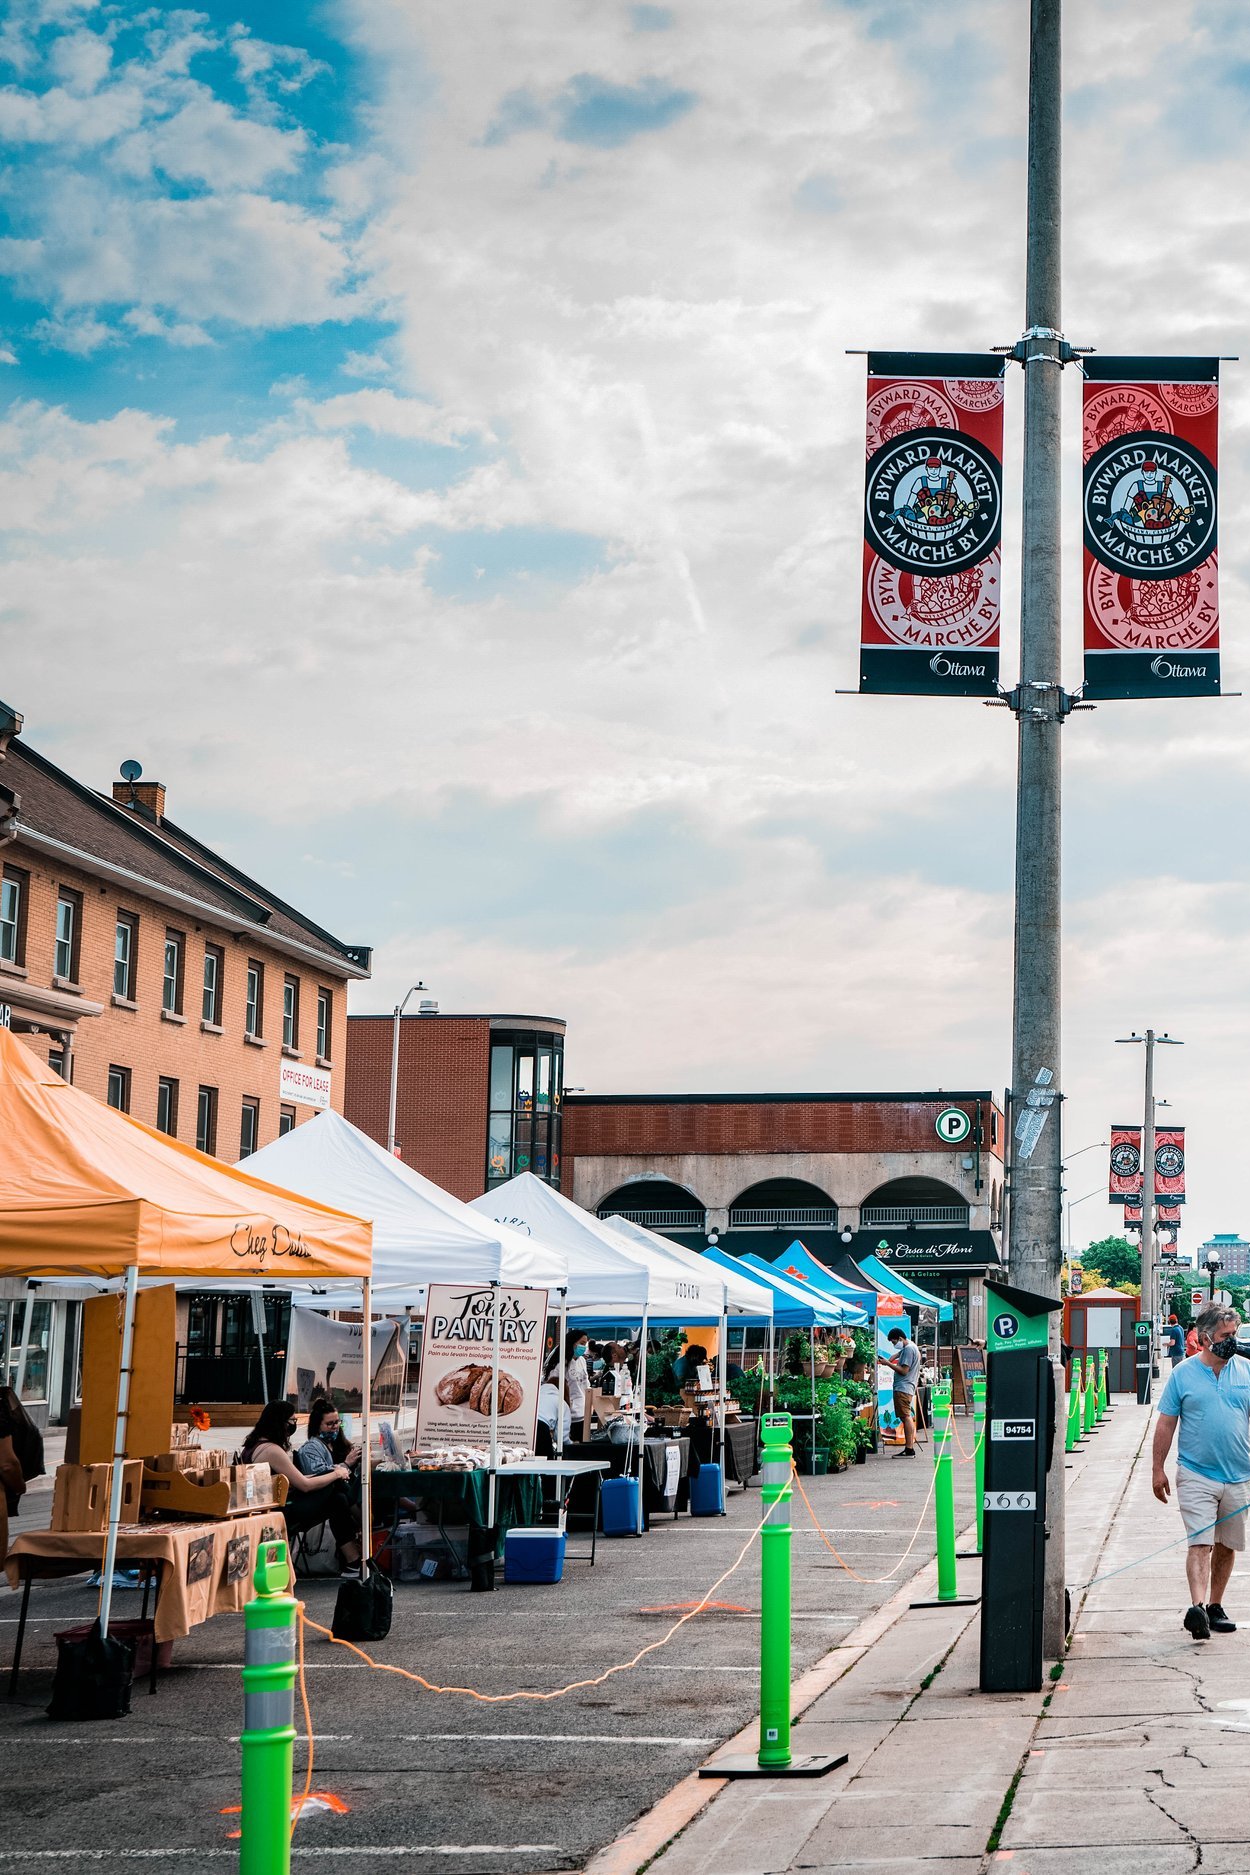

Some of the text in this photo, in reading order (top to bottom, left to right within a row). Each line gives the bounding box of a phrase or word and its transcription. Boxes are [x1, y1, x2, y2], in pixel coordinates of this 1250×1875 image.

[872, 389, 951, 430] BYWARD MARK
[992, 390, 1003, 400] BY
[1207, 392, 1217, 405] BY
[1087, 392, 1167, 434] BYWARD MARK
[875, 446, 930, 501] BYWARD
[937, 446, 993, 502] MARKET
[1092, 450, 1146, 506] BYWARD
[1152, 450, 1208, 508] MARKET
[882, 528, 980, 561] MARCHÉ BY
[1100, 530, 1197, 564] MARCHÉ BY
[879, 566, 897, 606] BYW
[1098, 571, 1115, 611] BYW
[903, 597, 998, 646] MARCHÉ BY
[1123, 601, 1216, 648] MARCHÉ BY
[930, 653, 986, 676] Ottawa
[1150, 655, 1207, 678] Ottawa
[282, 1069, 329, 1093] OFFICE FOR LEASE
[948, 1117, 961, 1135] P
[230, 1222, 267, 1263] Chez
[895, 1243, 973, 1257] Casa di Moni
[449, 1290, 525, 1320] Tom's
[432, 1315, 537, 1343] PANTRY
[469, 1352, 493, 1360] biologiq
[1005, 1426, 1032, 1434] 94754
